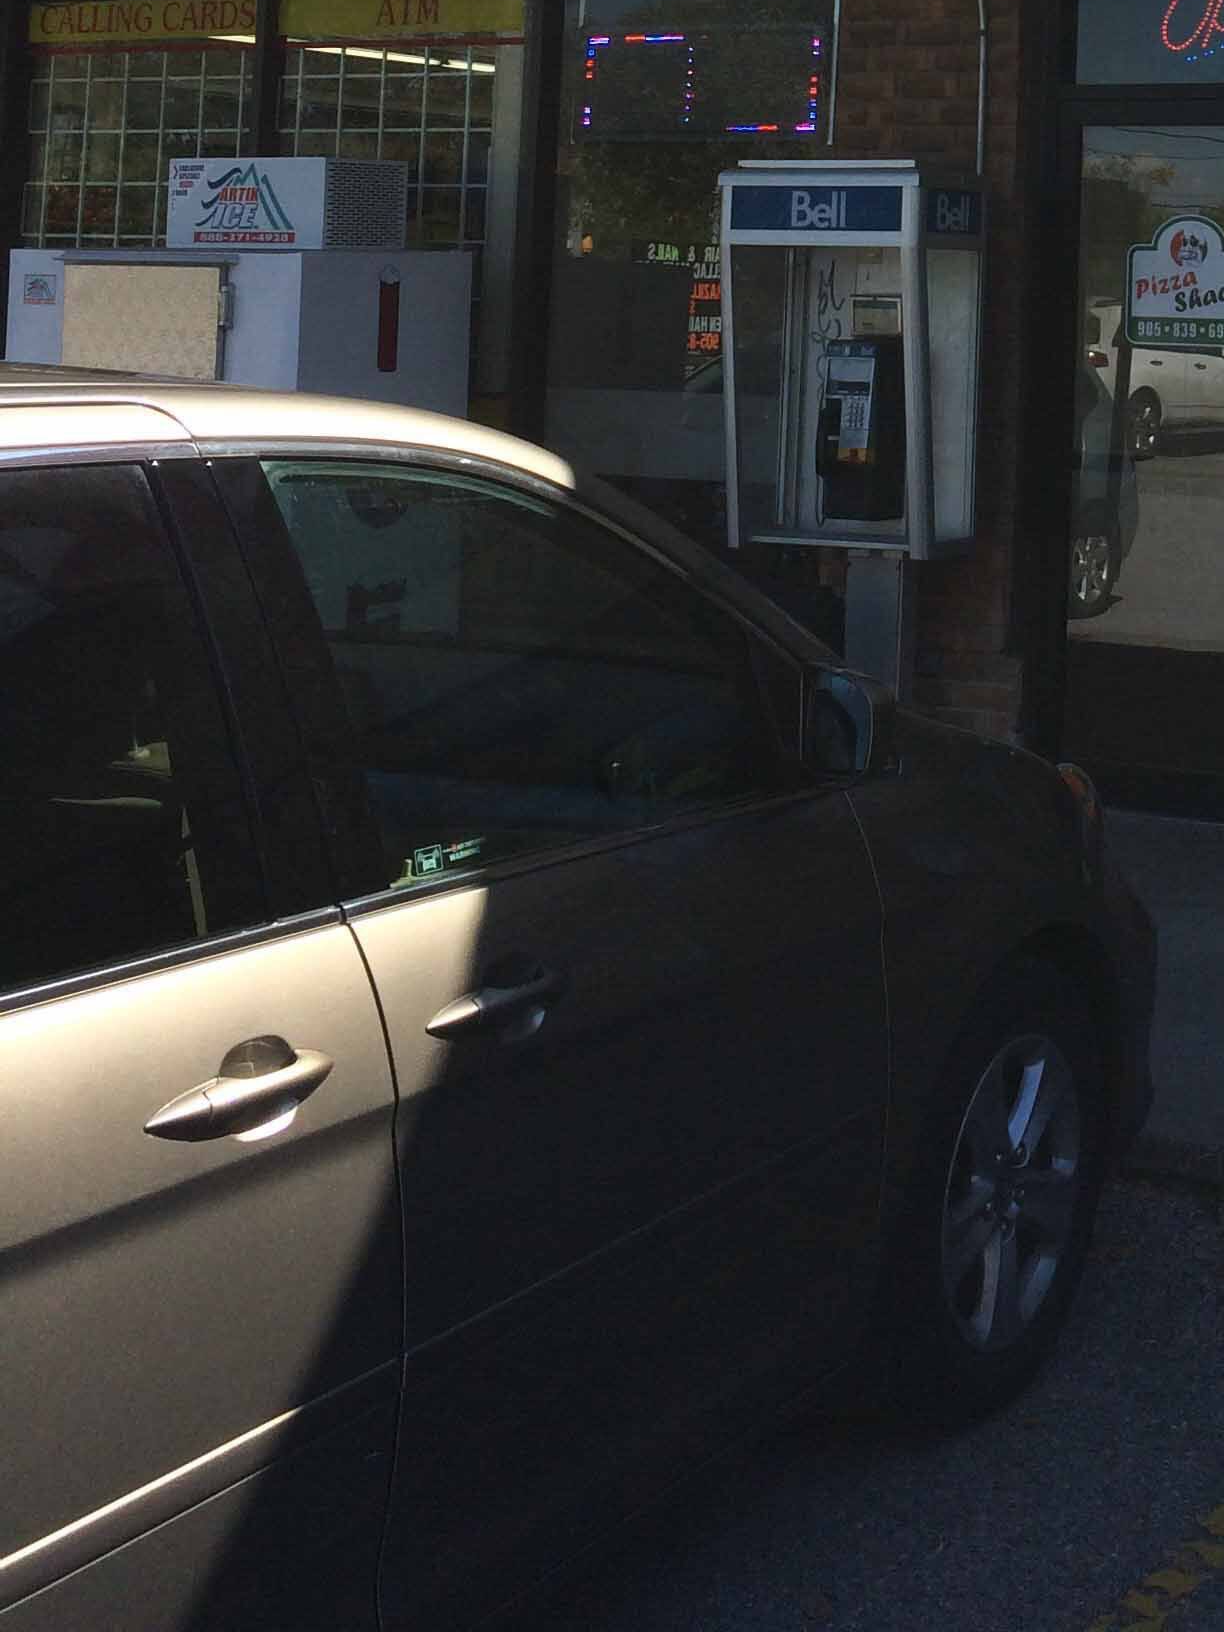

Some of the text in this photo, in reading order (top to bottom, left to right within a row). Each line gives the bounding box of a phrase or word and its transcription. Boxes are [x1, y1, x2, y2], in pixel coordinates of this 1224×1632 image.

[40, 0, 256, 34] CALLING CARDS
[791, 191, 847, 228] Bell
[936, 193, 970, 231] Bell
[1135, 271, 1198, 300] Pizza
